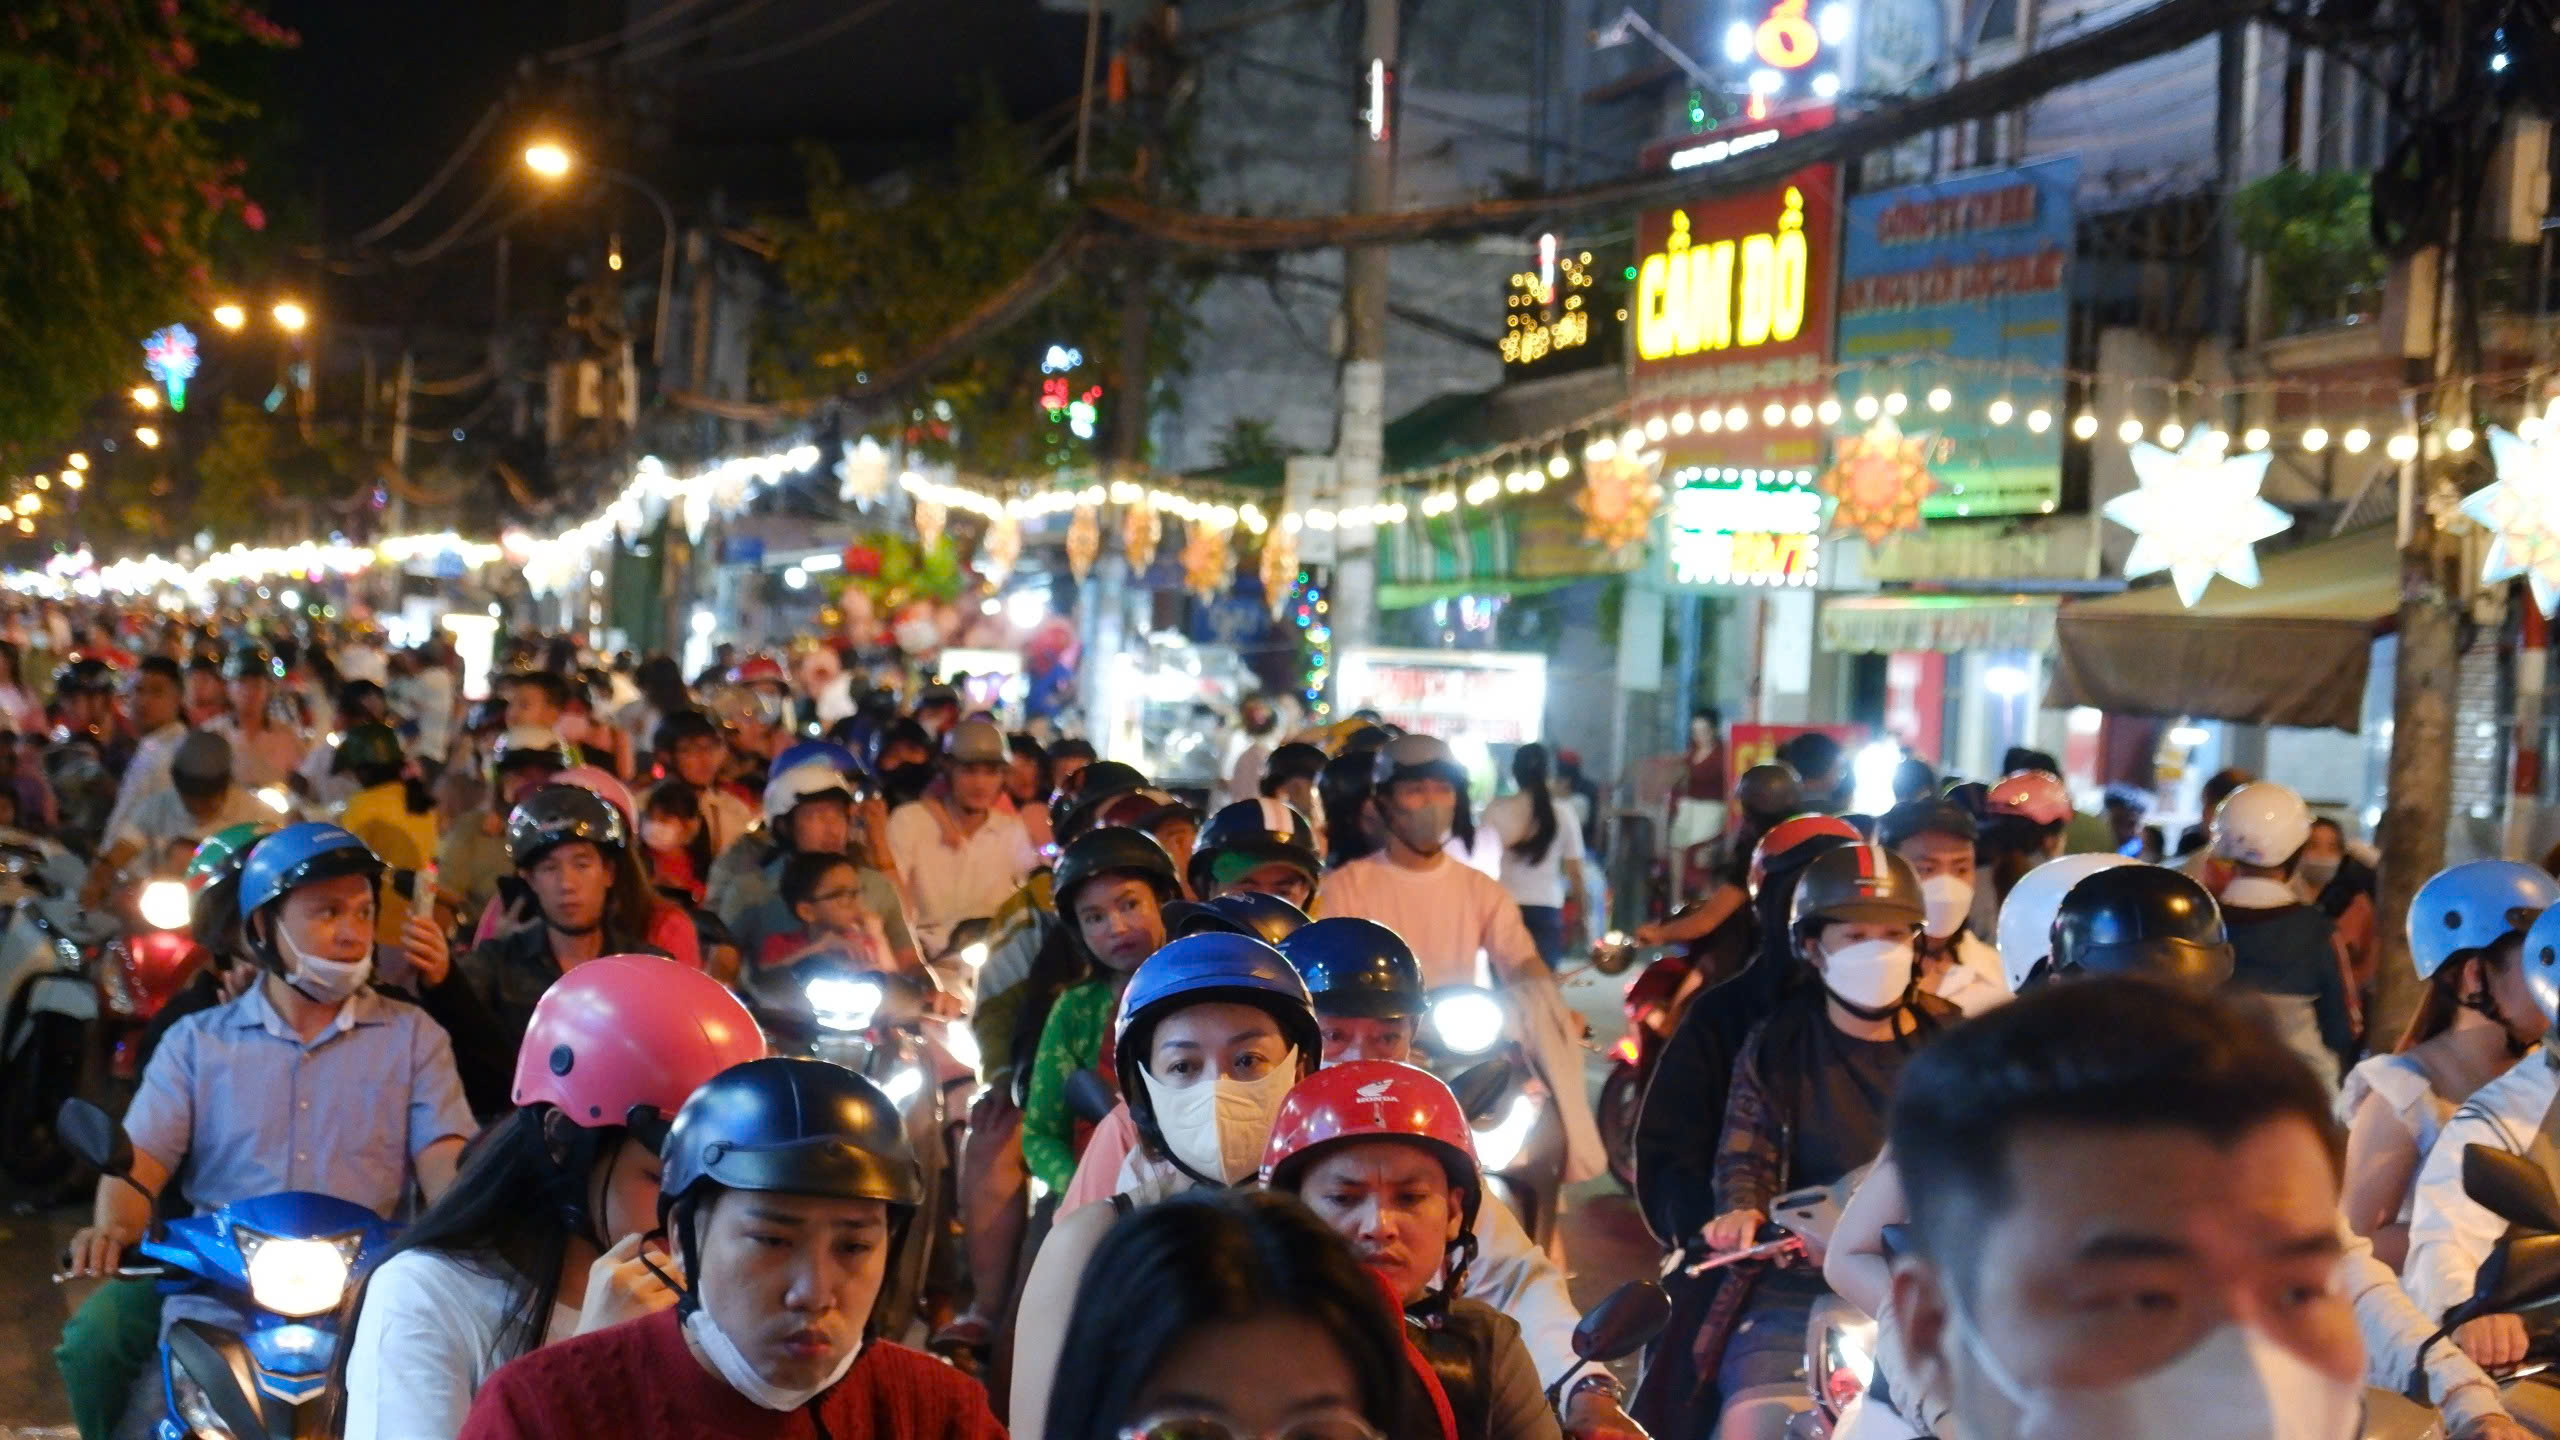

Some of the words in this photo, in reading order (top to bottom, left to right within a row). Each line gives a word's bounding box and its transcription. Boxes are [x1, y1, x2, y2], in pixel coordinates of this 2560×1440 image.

[1638, 208, 1735, 360] CẦM
[1738, 186, 1807, 346] ĐỒ
[1356, 1096, 1400, 1104] HONDA
